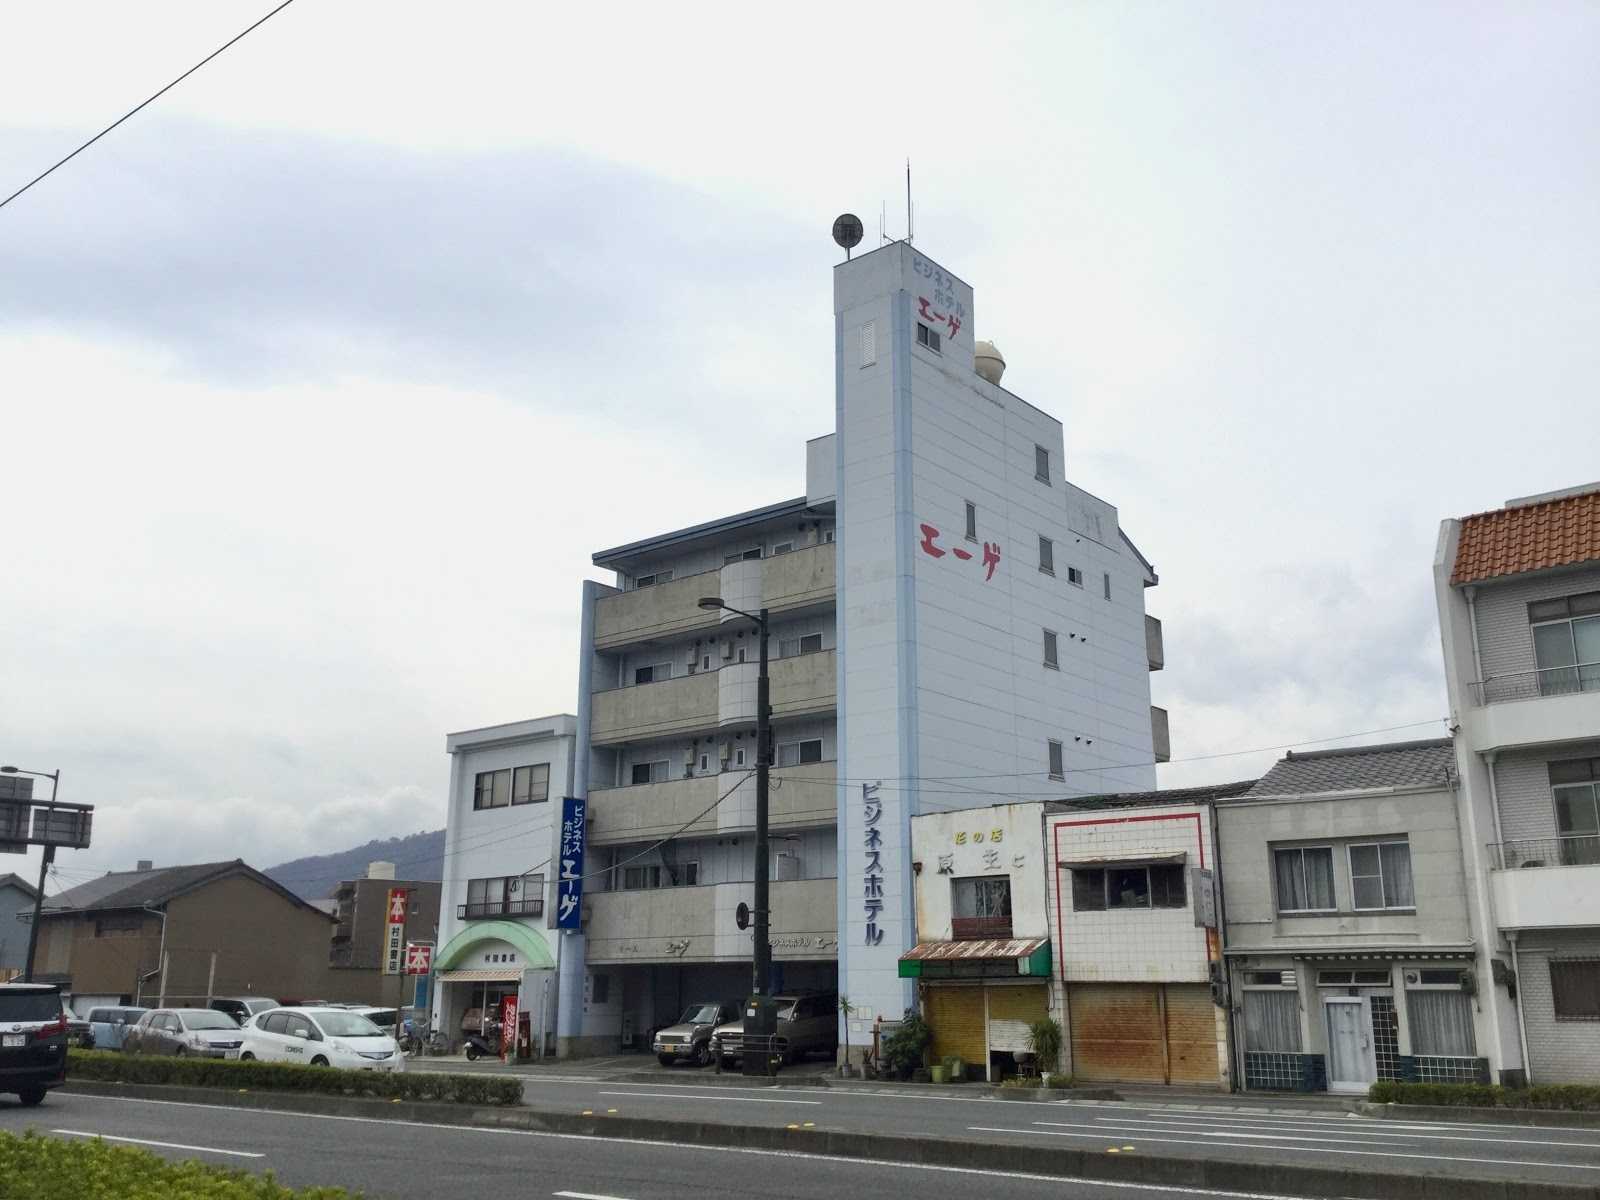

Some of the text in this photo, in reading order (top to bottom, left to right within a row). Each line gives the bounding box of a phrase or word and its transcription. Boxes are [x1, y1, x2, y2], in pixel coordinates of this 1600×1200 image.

[918, 296, 961, 340] エーゲ
[934, 288, 966, 317] ホテル
[920, 523, 1000, 582] エーゲ
[562, 820, 573, 856] ホテル
[572, 804, 583, 854] ビジネス
[862, 780, 885, 947] ビジネスホテル
[390, 892, 404, 921] 本
[560, 859, 580, 921] エーゲ
[408, 948, 428, 973] 本
